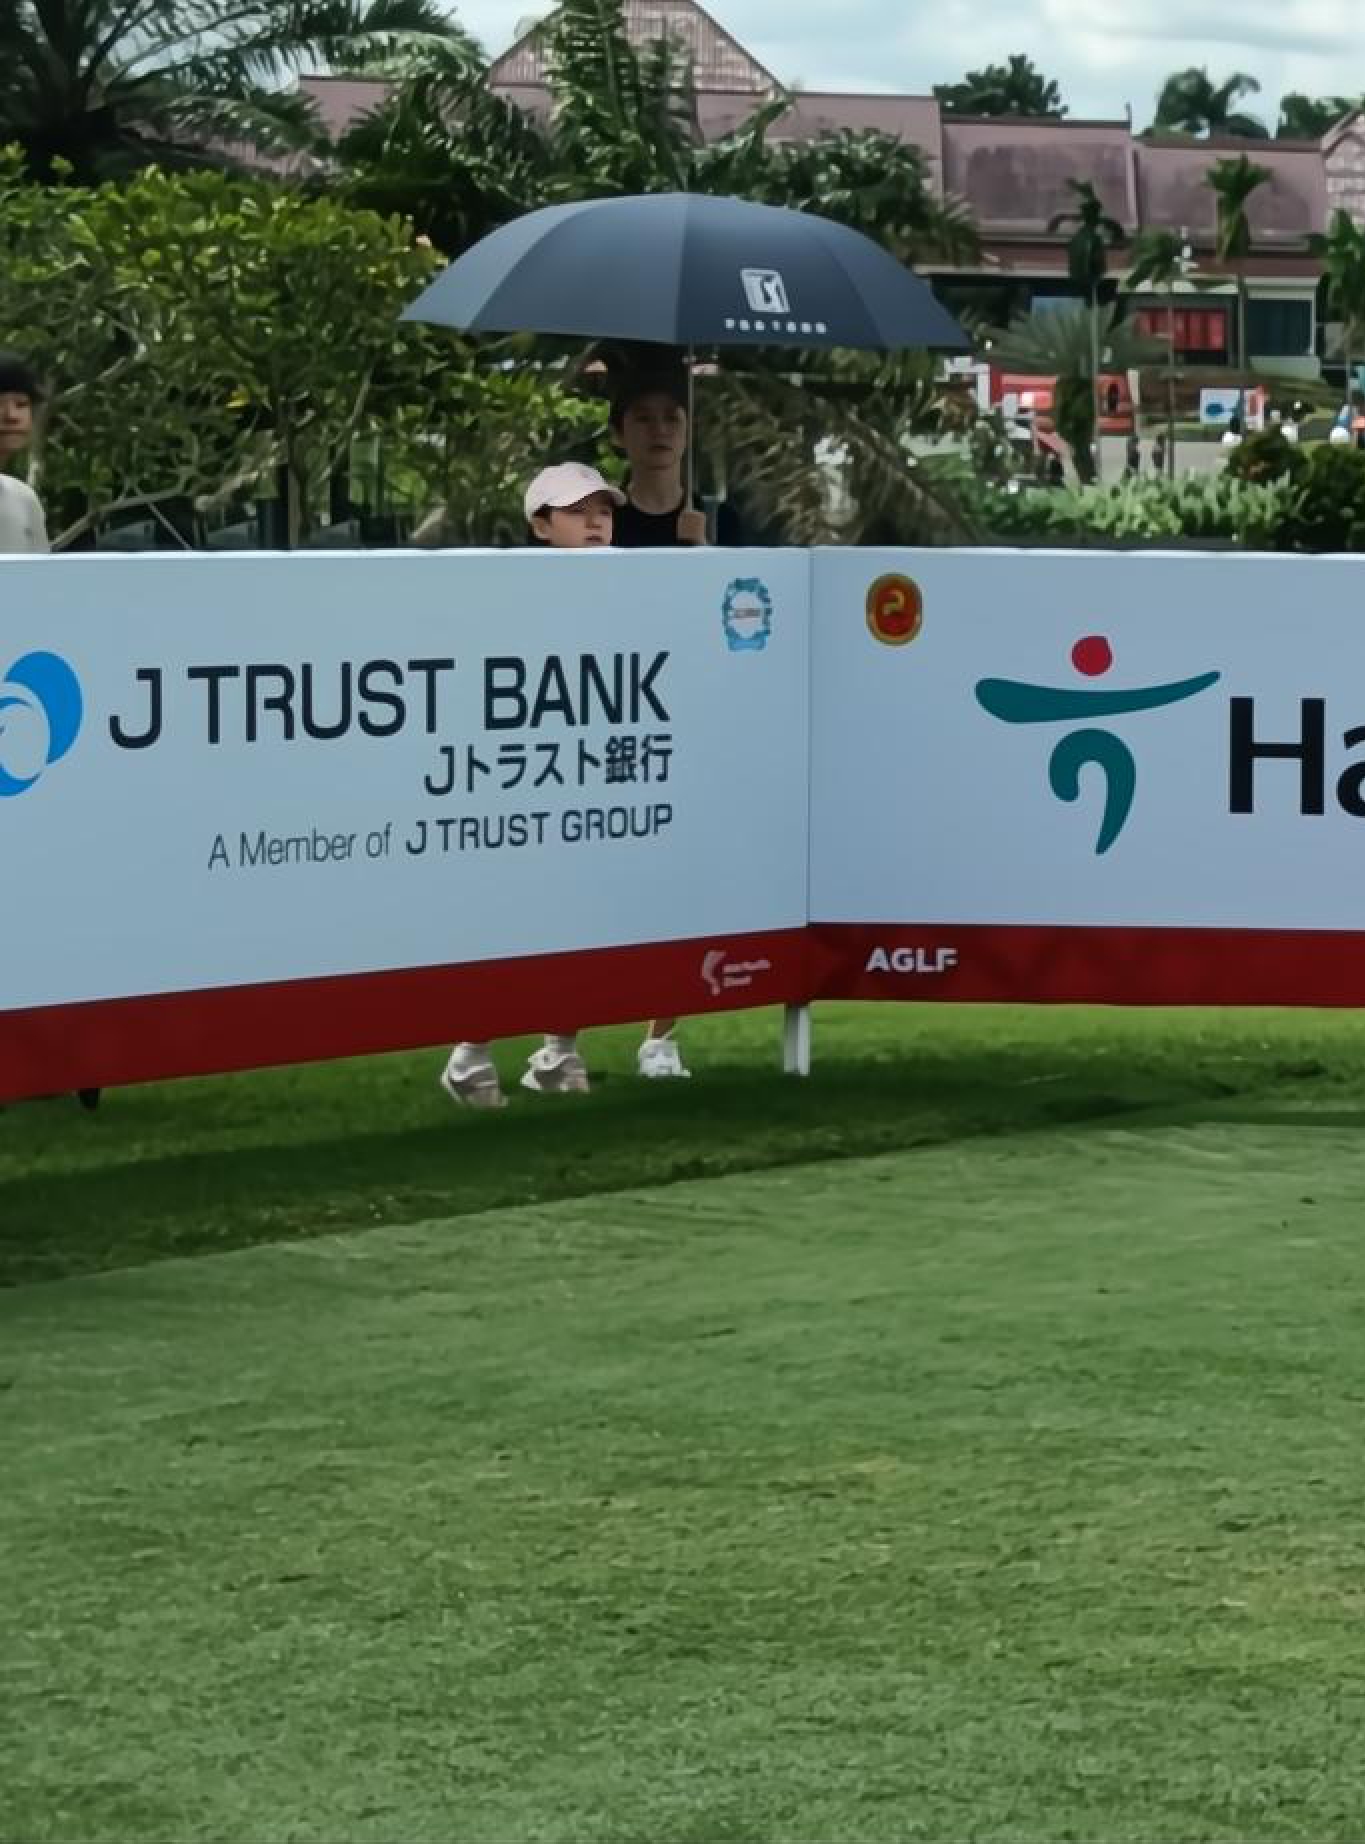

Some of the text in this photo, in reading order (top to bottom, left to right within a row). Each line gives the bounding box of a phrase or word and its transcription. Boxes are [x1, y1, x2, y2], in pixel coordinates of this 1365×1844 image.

[109, 651, 672, 750] J TRUST BANK
[423, 733, 674, 797] Jトラスト銀行
[207, 803, 674, 870] A Member of J TRUST GROUP
[865, 947, 959, 973] AGLF
